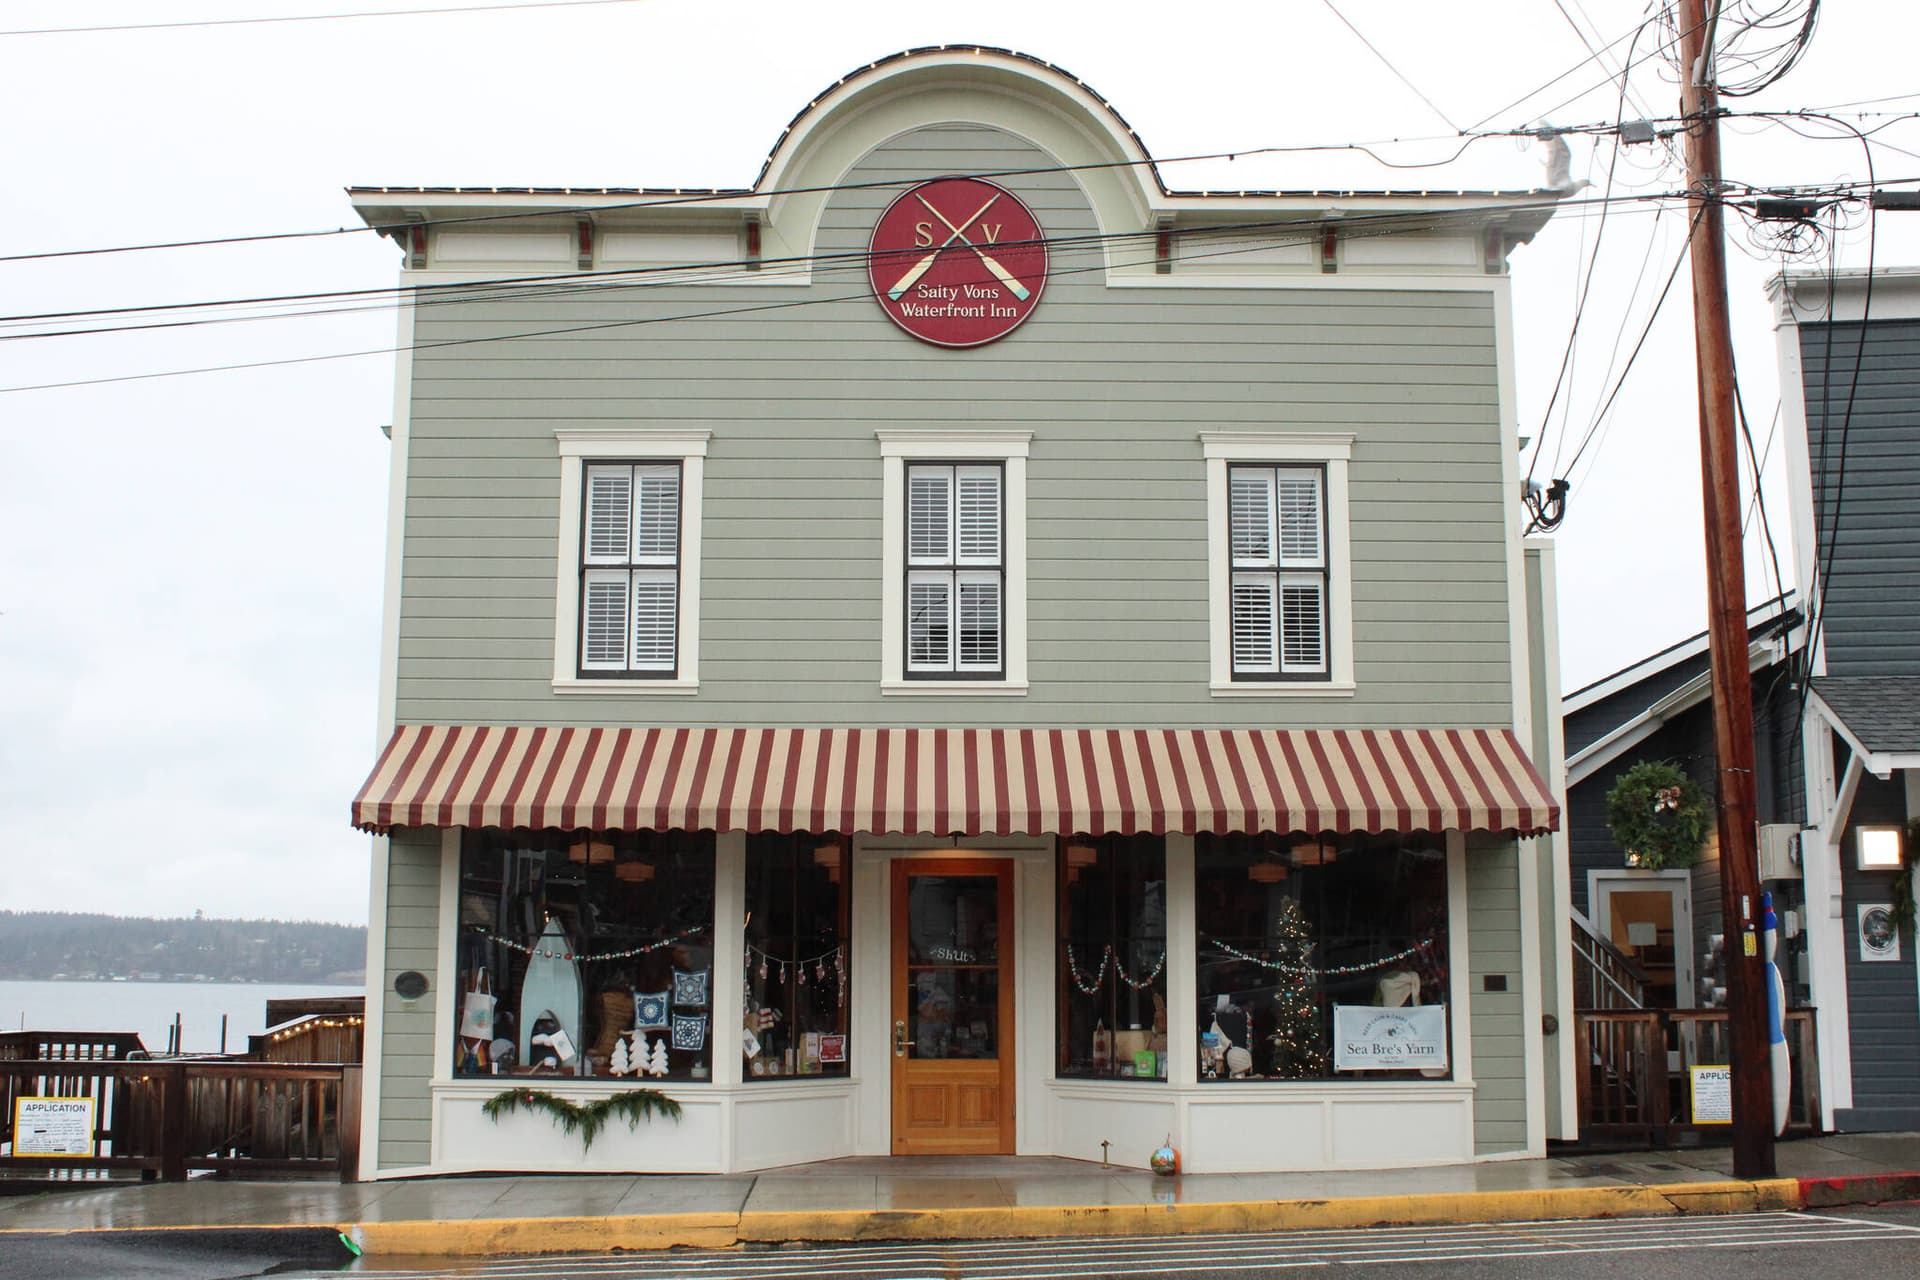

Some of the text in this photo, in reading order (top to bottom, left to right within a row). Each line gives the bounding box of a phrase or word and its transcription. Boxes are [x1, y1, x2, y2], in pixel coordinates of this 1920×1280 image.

[915, 222, 1002, 248] S V
[918, 284, 999, 301] Salty Vons
[900, 303, 1017, 318] Waterfront Inn
[1347, 1043, 1435, 1055] Sea Bre's Yarn
[25, 1103, 86, 1112] APPLICATION
